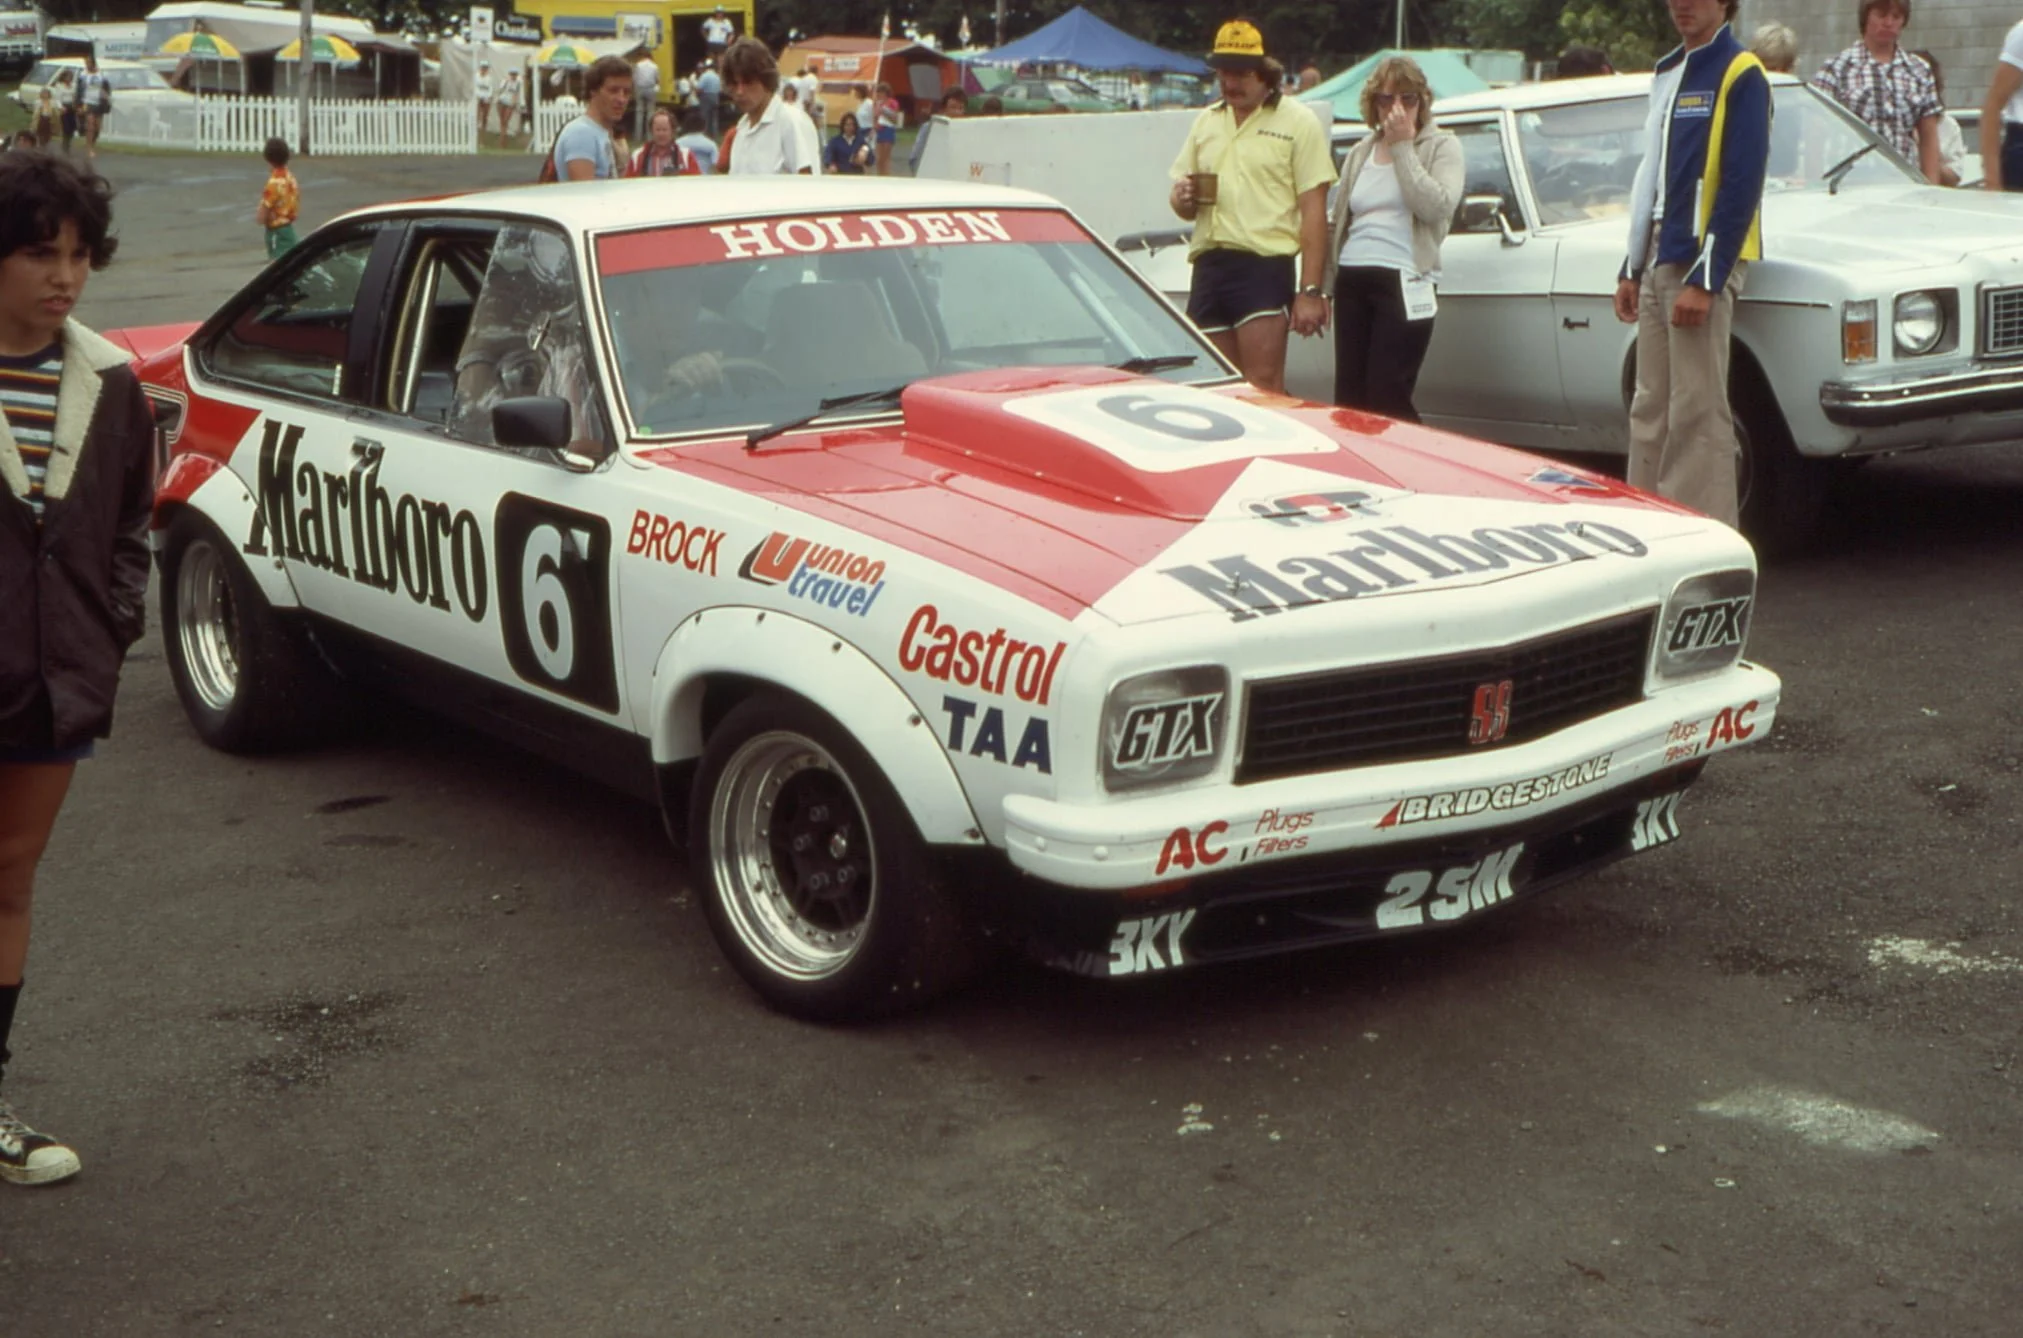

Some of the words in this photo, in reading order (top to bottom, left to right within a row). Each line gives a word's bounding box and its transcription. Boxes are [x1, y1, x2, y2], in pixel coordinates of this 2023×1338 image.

[710, 211, 1012, 259] HOLDEN
[1096, 395, 1246, 442] 6
[243, 418, 488, 623] Marlboro
[627, 509, 726, 577] BROCK
[522, 523, 574, 681] 6
[788, 562, 885, 617] travel
[1157, 520, 1649, 623] Marlboro
[898, 604, 1067, 706] Castrol
[1668, 596, 1751, 654] GTX
[943, 695, 1052, 775] TAA
[1113, 692, 1224, 770] GTX
[1468, 680, 1513, 745] SS
[1705, 699, 1758, 750] AC
[1398, 752, 1614, 825] BRIDGESTONE
[1155, 819, 1229, 876] AC
[1255, 808, 1315, 835] Plugs
[1108, 907, 1197, 976] 3KY
